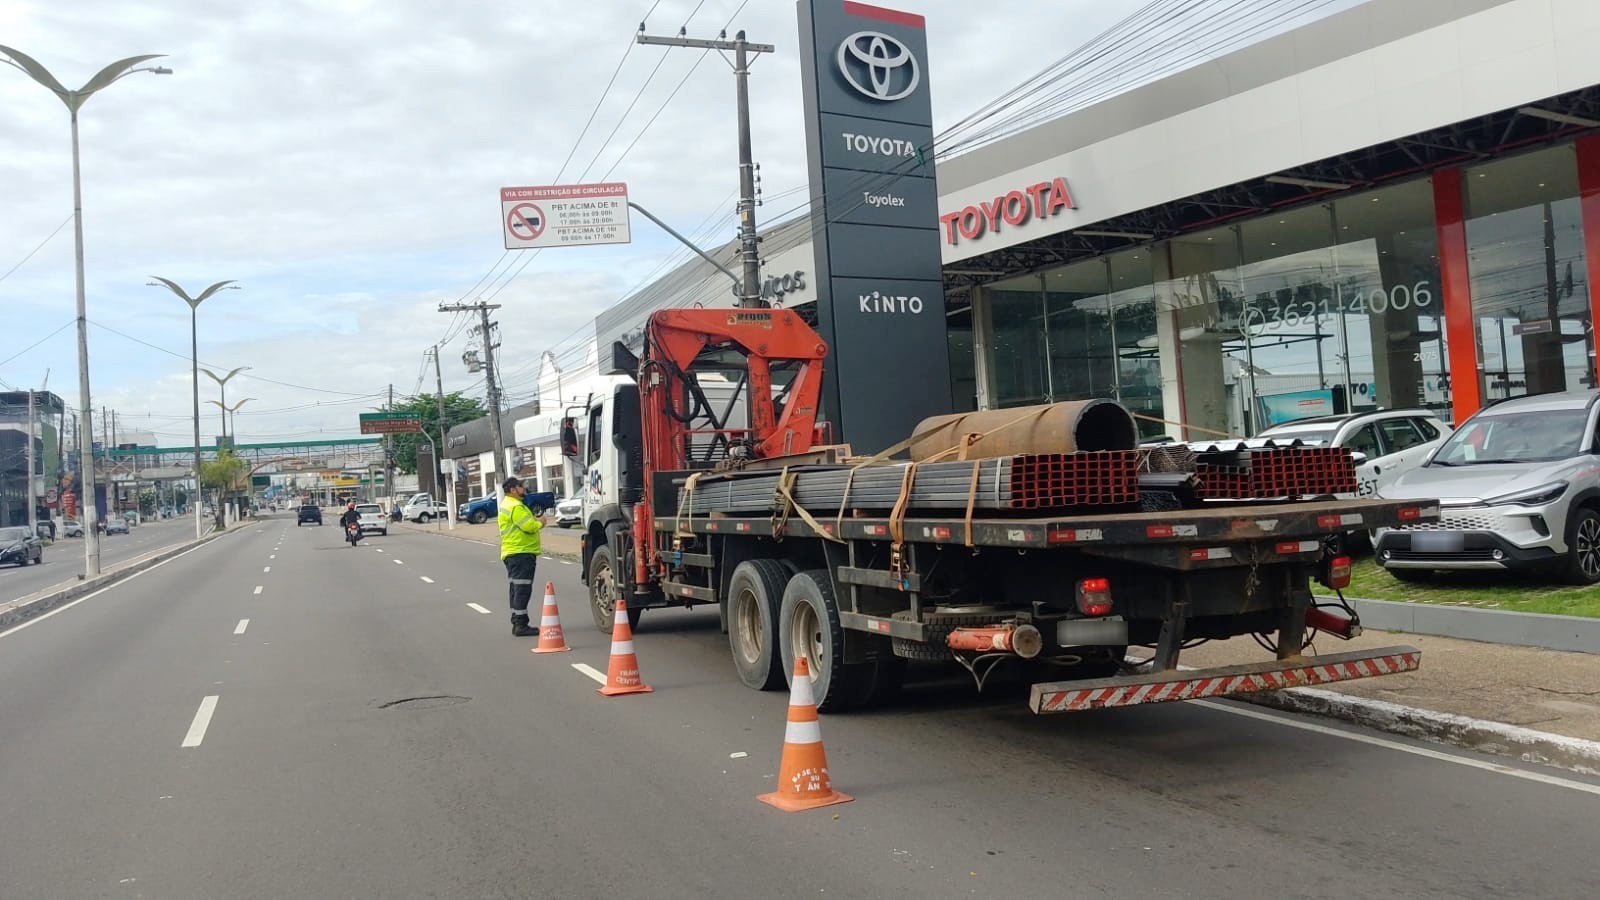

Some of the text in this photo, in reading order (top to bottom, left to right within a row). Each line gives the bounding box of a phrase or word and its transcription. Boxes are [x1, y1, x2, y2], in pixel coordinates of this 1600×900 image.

[842, 133, 916, 158] TOYOTA
[504, 190, 517, 198] VIA
[534, 188, 572, 197] RESTRIÇÃO
[582, 186, 624, 195] CIRCULAÇÃO
[863, 191, 904, 207] Toyolex
[569, 202, 596, 211] ACIMA
[597, 201, 609, 209] DE
[940, 177, 1077, 246] TOYOTA
[572, 227, 594, 235] ACIMA
[595, 226, 606, 234] DE
